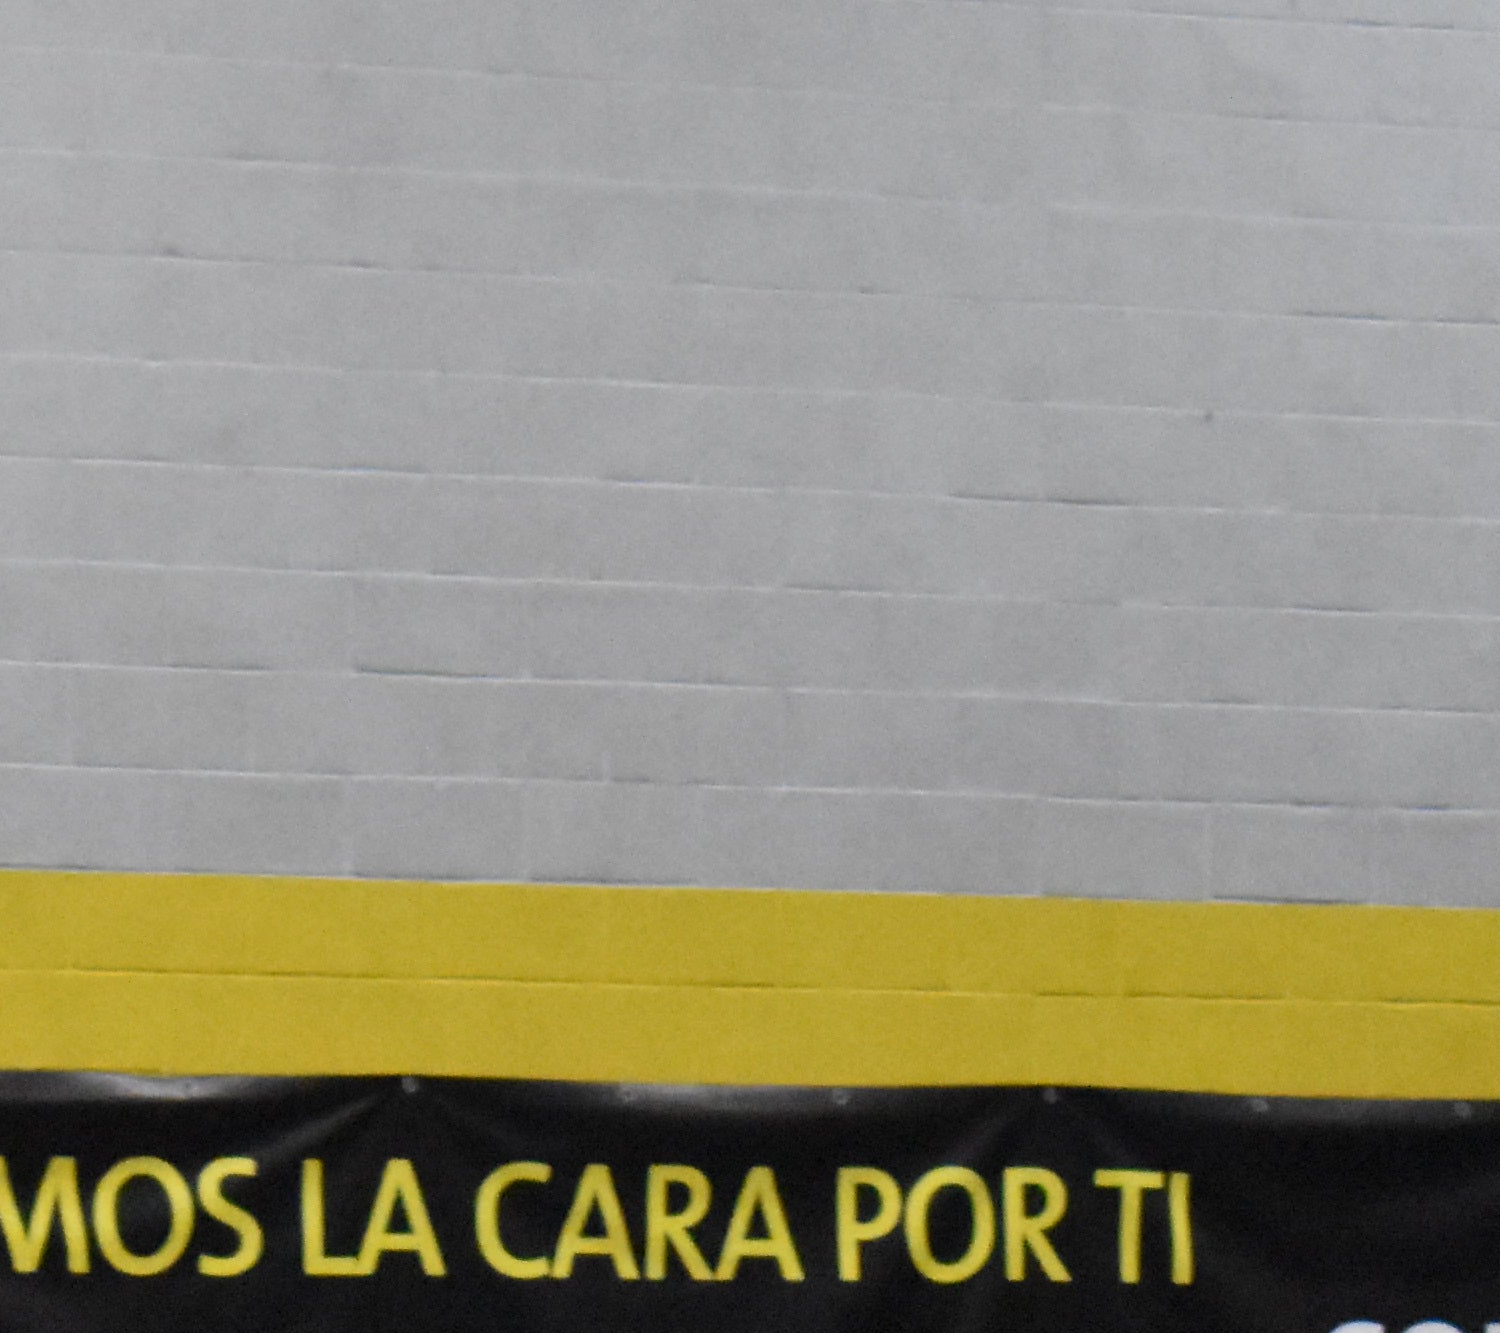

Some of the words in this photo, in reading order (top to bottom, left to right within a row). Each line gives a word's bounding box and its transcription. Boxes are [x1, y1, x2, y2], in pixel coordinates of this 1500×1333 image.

[301, 1158, 446, 1277] LA
[474, 1161, 805, 1282] CARA
[837, 1166, 1072, 1284] POR
[1094, 1169, 1194, 1286] TI
